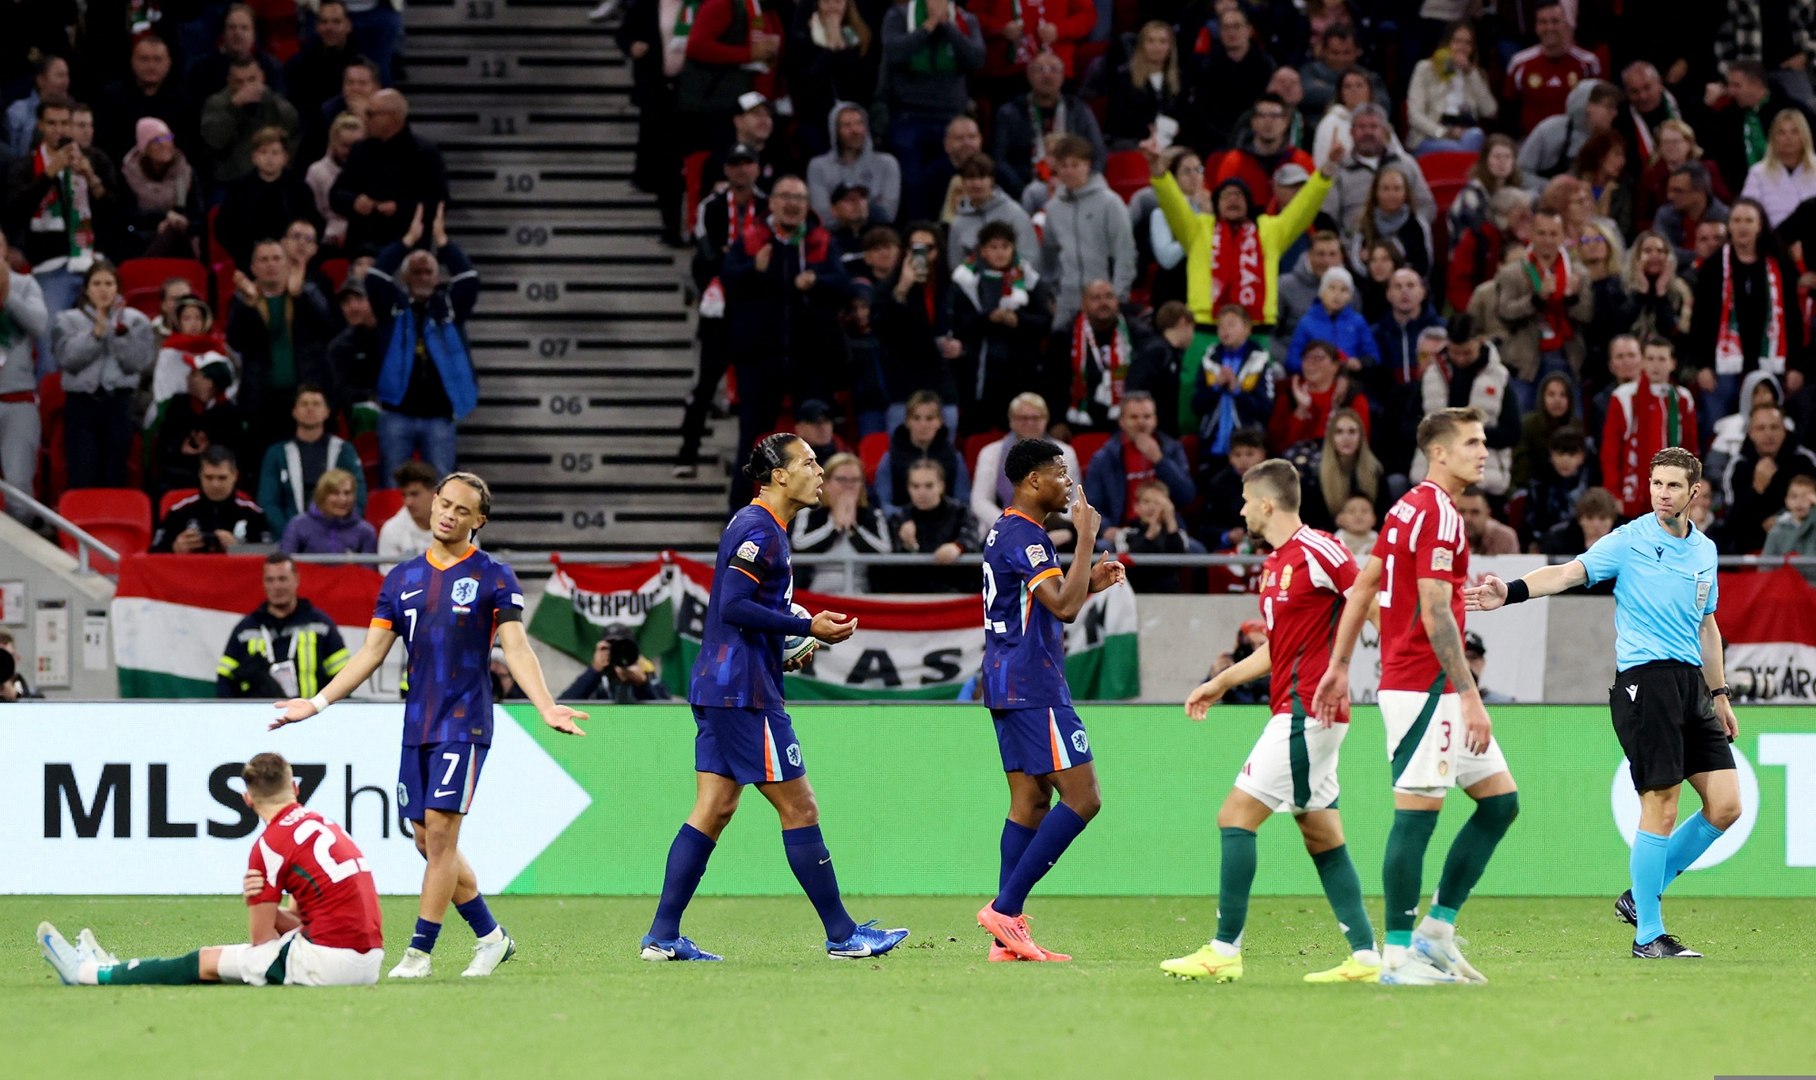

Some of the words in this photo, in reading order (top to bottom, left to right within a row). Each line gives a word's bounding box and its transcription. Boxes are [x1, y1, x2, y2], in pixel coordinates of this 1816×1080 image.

[490, 116, 517, 136] 11
[504, 172, 535, 194] 10
[515, 225, 549, 247] 09
[526, 282, 560, 302] 08
[539, 337, 571, 358] 07
[550, 395, 583, 416] 06
[560, 452, 594, 473] 05
[572, 509, 607, 531] 04
[403, 608, 418, 642] 7
[1440, 720, 1451, 752] 3
[442, 752, 460, 786] 7
